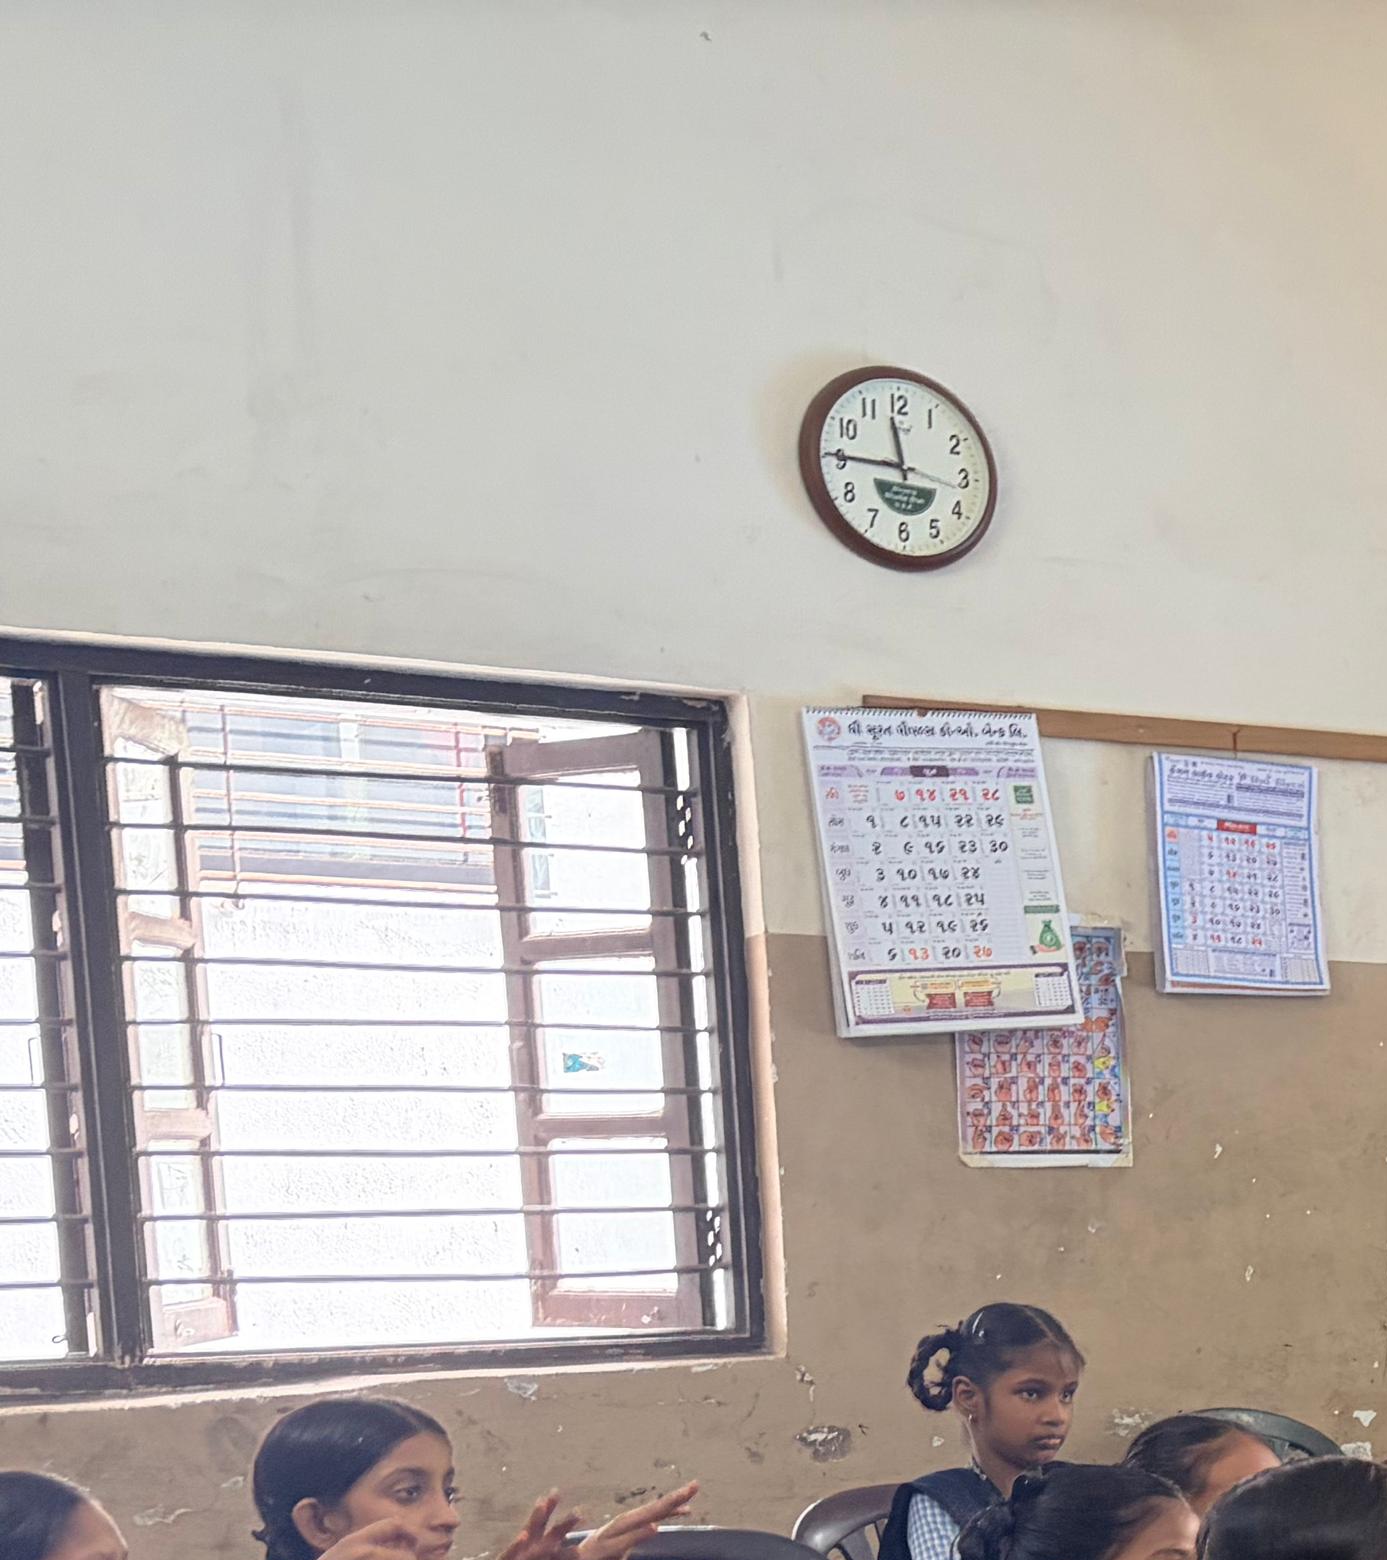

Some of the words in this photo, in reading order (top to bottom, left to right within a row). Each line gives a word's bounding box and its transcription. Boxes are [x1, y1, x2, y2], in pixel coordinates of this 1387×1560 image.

[862, 397, 876, 420] 11
[891, 393, 909, 416] 12
[839, 417, 858, 440] 10
[927, 409, 933, 429] 1
[949, 435, 961, 455] 2
[836, 449, 847, 470] 9
[957, 468, 970, 490] 3
[843, 482, 856, 503] 8
[867, 508, 879, 528] 7
[951, 500, 964, 520] 4
[900, 522, 910, 543] 6
[928, 519, 940, 539] 5
[895, 789, 905, 801] ૭
[915, 788, 937, 801] ૧૪
[949, 788, 969, 801] ૨૧
[982, 788, 1000, 801] ૨૮
[866, 815, 878, 829] ૧
[900, 815, 909, 828] ૮
[918, 814, 941, 829] ૧૫
[954, 814, 974, 828] ૨૨
[985, 813, 1005, 828] ૨૯
[872, 841, 882, 855] ૨
[904, 841, 914, 855] ૯
[924, 840, 945, 854] ૧૬
[958, 840, 978, 853] ૨૩
[989, 840, 1008, 853] ૩૦
[875, 867, 886, 881] ૩
[896, 868, 917, 881] ૧૦
[928, 867, 949, 880] ૧૭
[961, 866, 980, 880] ૨૪
[879, 895, 888, 909] ૪
[900, 894, 921, 908] ૧૧
[932, 894, 953, 907] ૧૮
[965, 892, 985, 906] ૨૫
[881, 921, 894, 935] ૫
[905, 920, 926, 934] ૧૨
[936, 920, 957, 933] ૧૯
[969, 918, 989, 932] ૨૬
[887, 947, 898, 961] ૬
[908, 947, 930, 960] ૧૩
[941, 946, 961, 960] ૨૦
[973, 944, 993, 958] ૨૭
